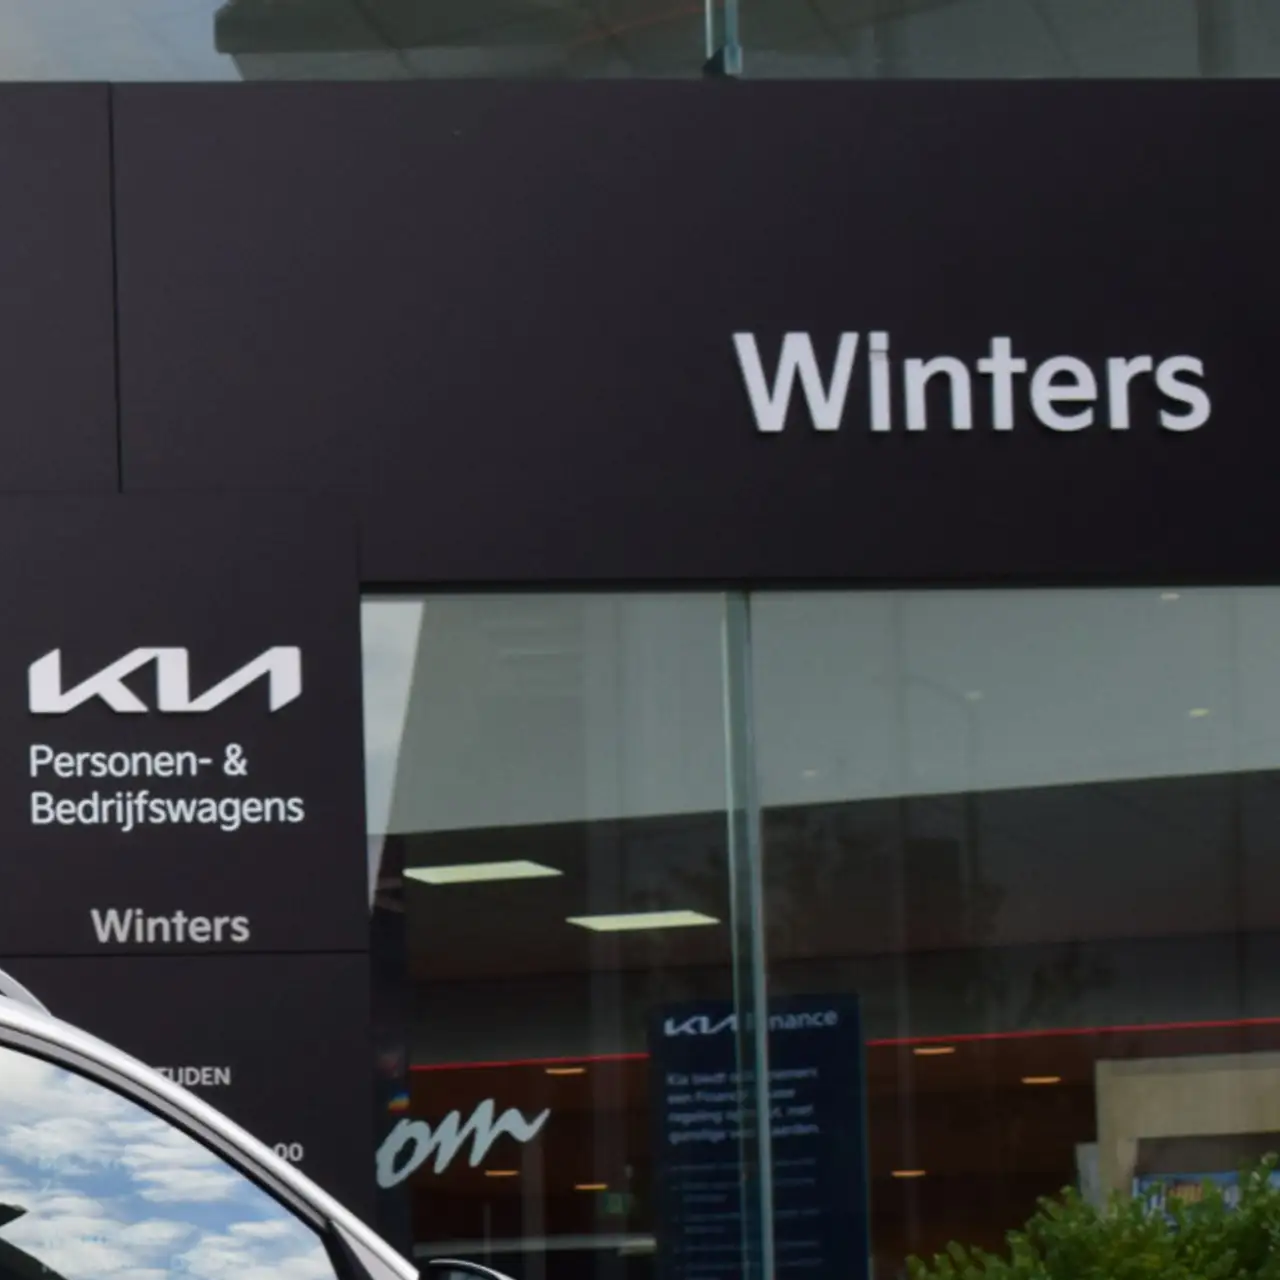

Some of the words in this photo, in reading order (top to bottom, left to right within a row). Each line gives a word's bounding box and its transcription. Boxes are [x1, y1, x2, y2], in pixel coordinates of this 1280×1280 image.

[732, 331, 1210, 433] Winters
[28, 646, 302, 713] KIA
[29, 744, 213, 778] Personen-
[223, 743, 248, 776] &
[30, 790, 305, 832] Bedrijfswagens
[90, 908, 251, 943] Winters
